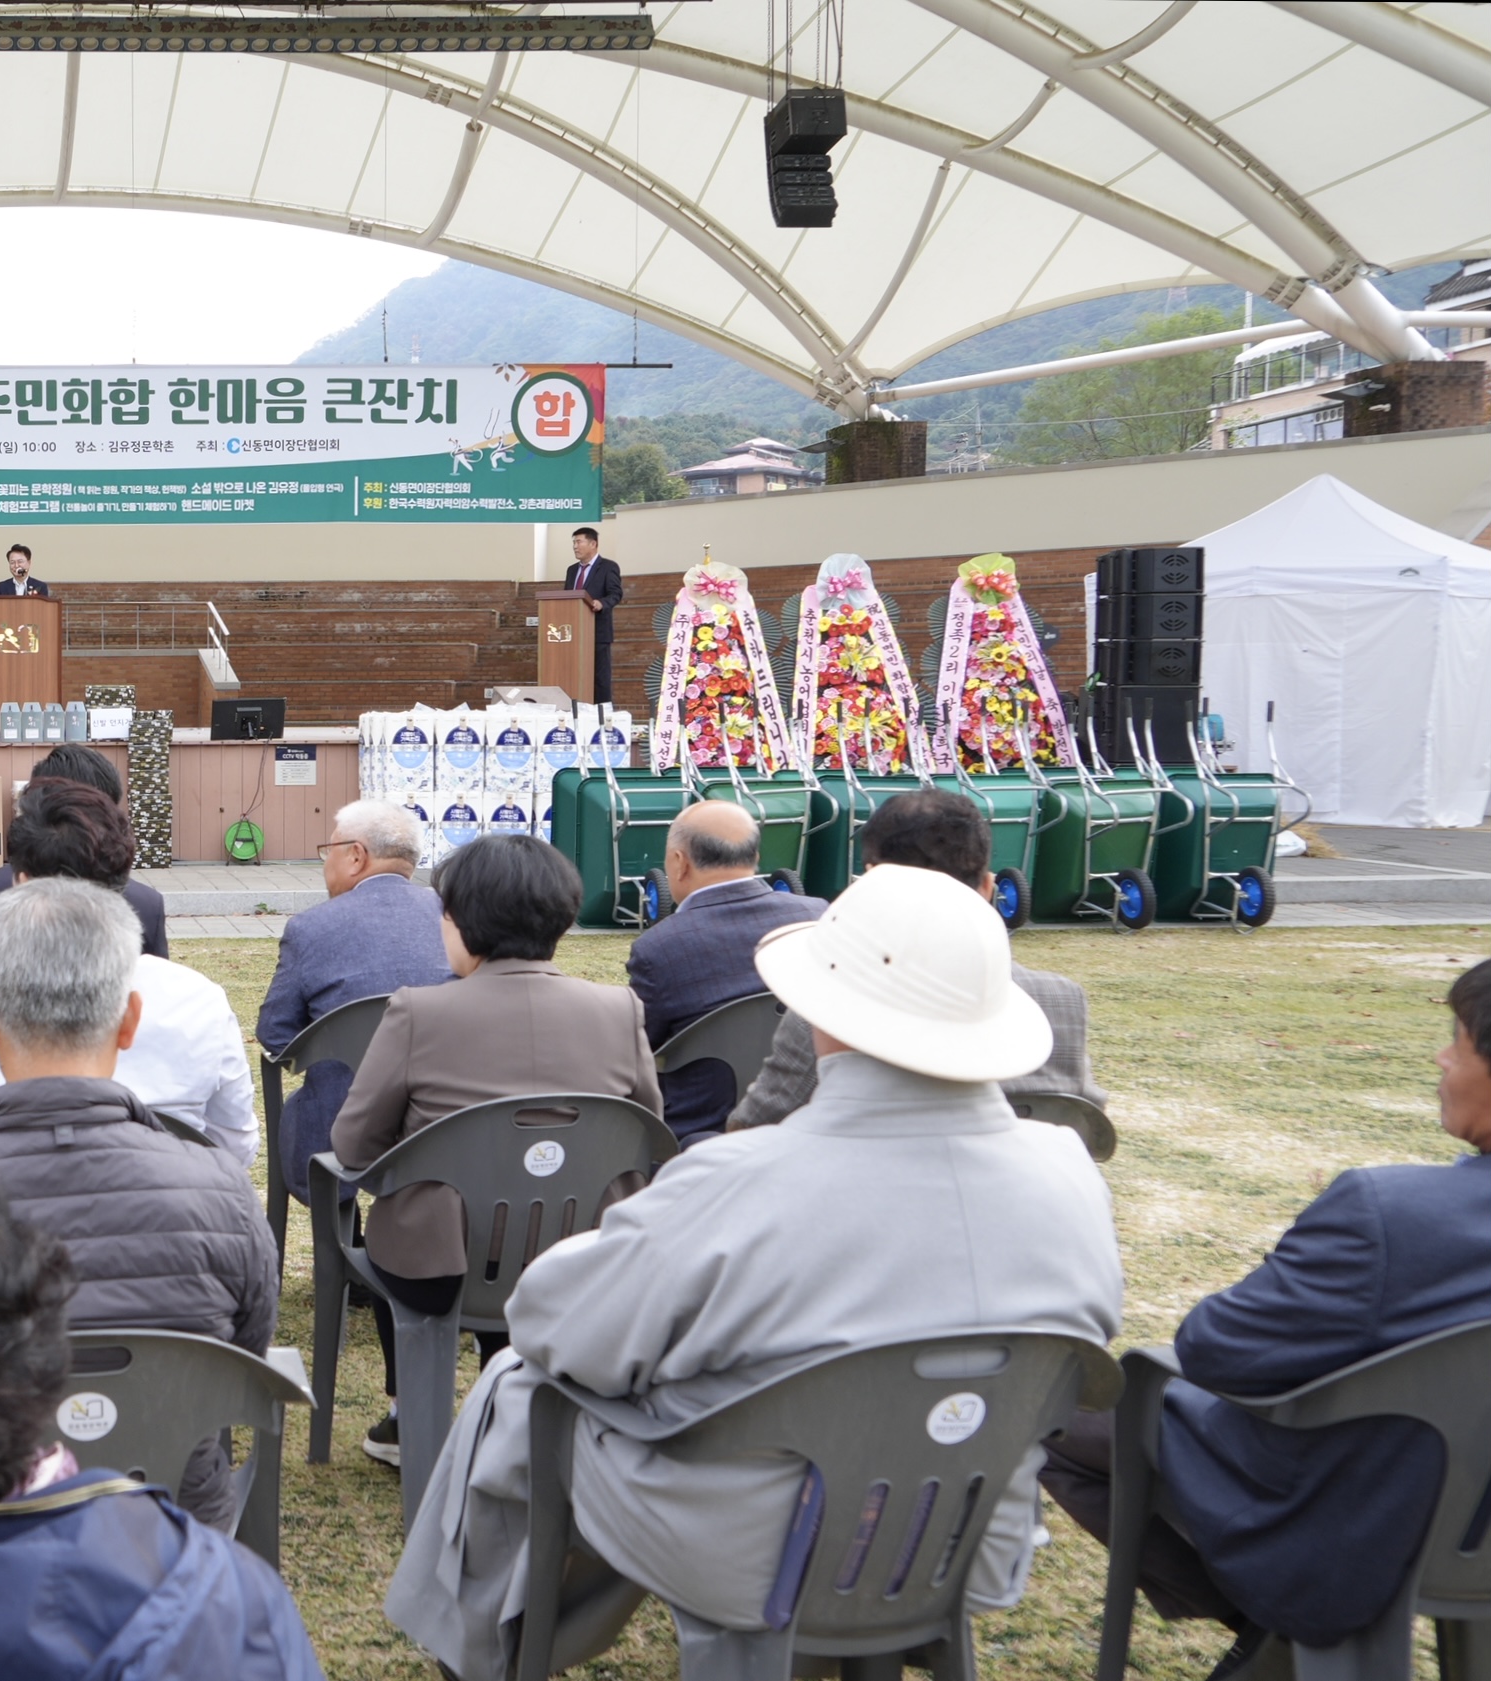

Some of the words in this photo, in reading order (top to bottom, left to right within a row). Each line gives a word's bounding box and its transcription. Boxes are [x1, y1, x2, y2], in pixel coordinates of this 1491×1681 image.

[168, 378, 307, 425] 한마음
[322, 378, 458, 425] 큰잔치
[533, 391, 575, 438] 합
[22, 441, 57, 453] 10:00
[75, 440, 98, 454] 장소
[108, 439, 175, 454] 김유정문학촌
[195, 439, 218, 453] 주최
[241, 438, 340, 452] 신동면이장단협의회
[31, 483, 73, 496] 문학정원
[191, 482, 212, 494] 소설
[214, 482, 245, 494] 밖으로
[246, 482, 267, 494] 나온
[268, 481, 299, 494] 김유정
[363, 482, 383, 494] 주최
[389, 482, 471, 494] 신동면이장단협의회
[181, 499, 233, 512] 핸드메이드
[234, 499, 255, 511] 마켓
[363, 498, 383, 509] 후원
[873, 618, 900, 667] 신동면민
